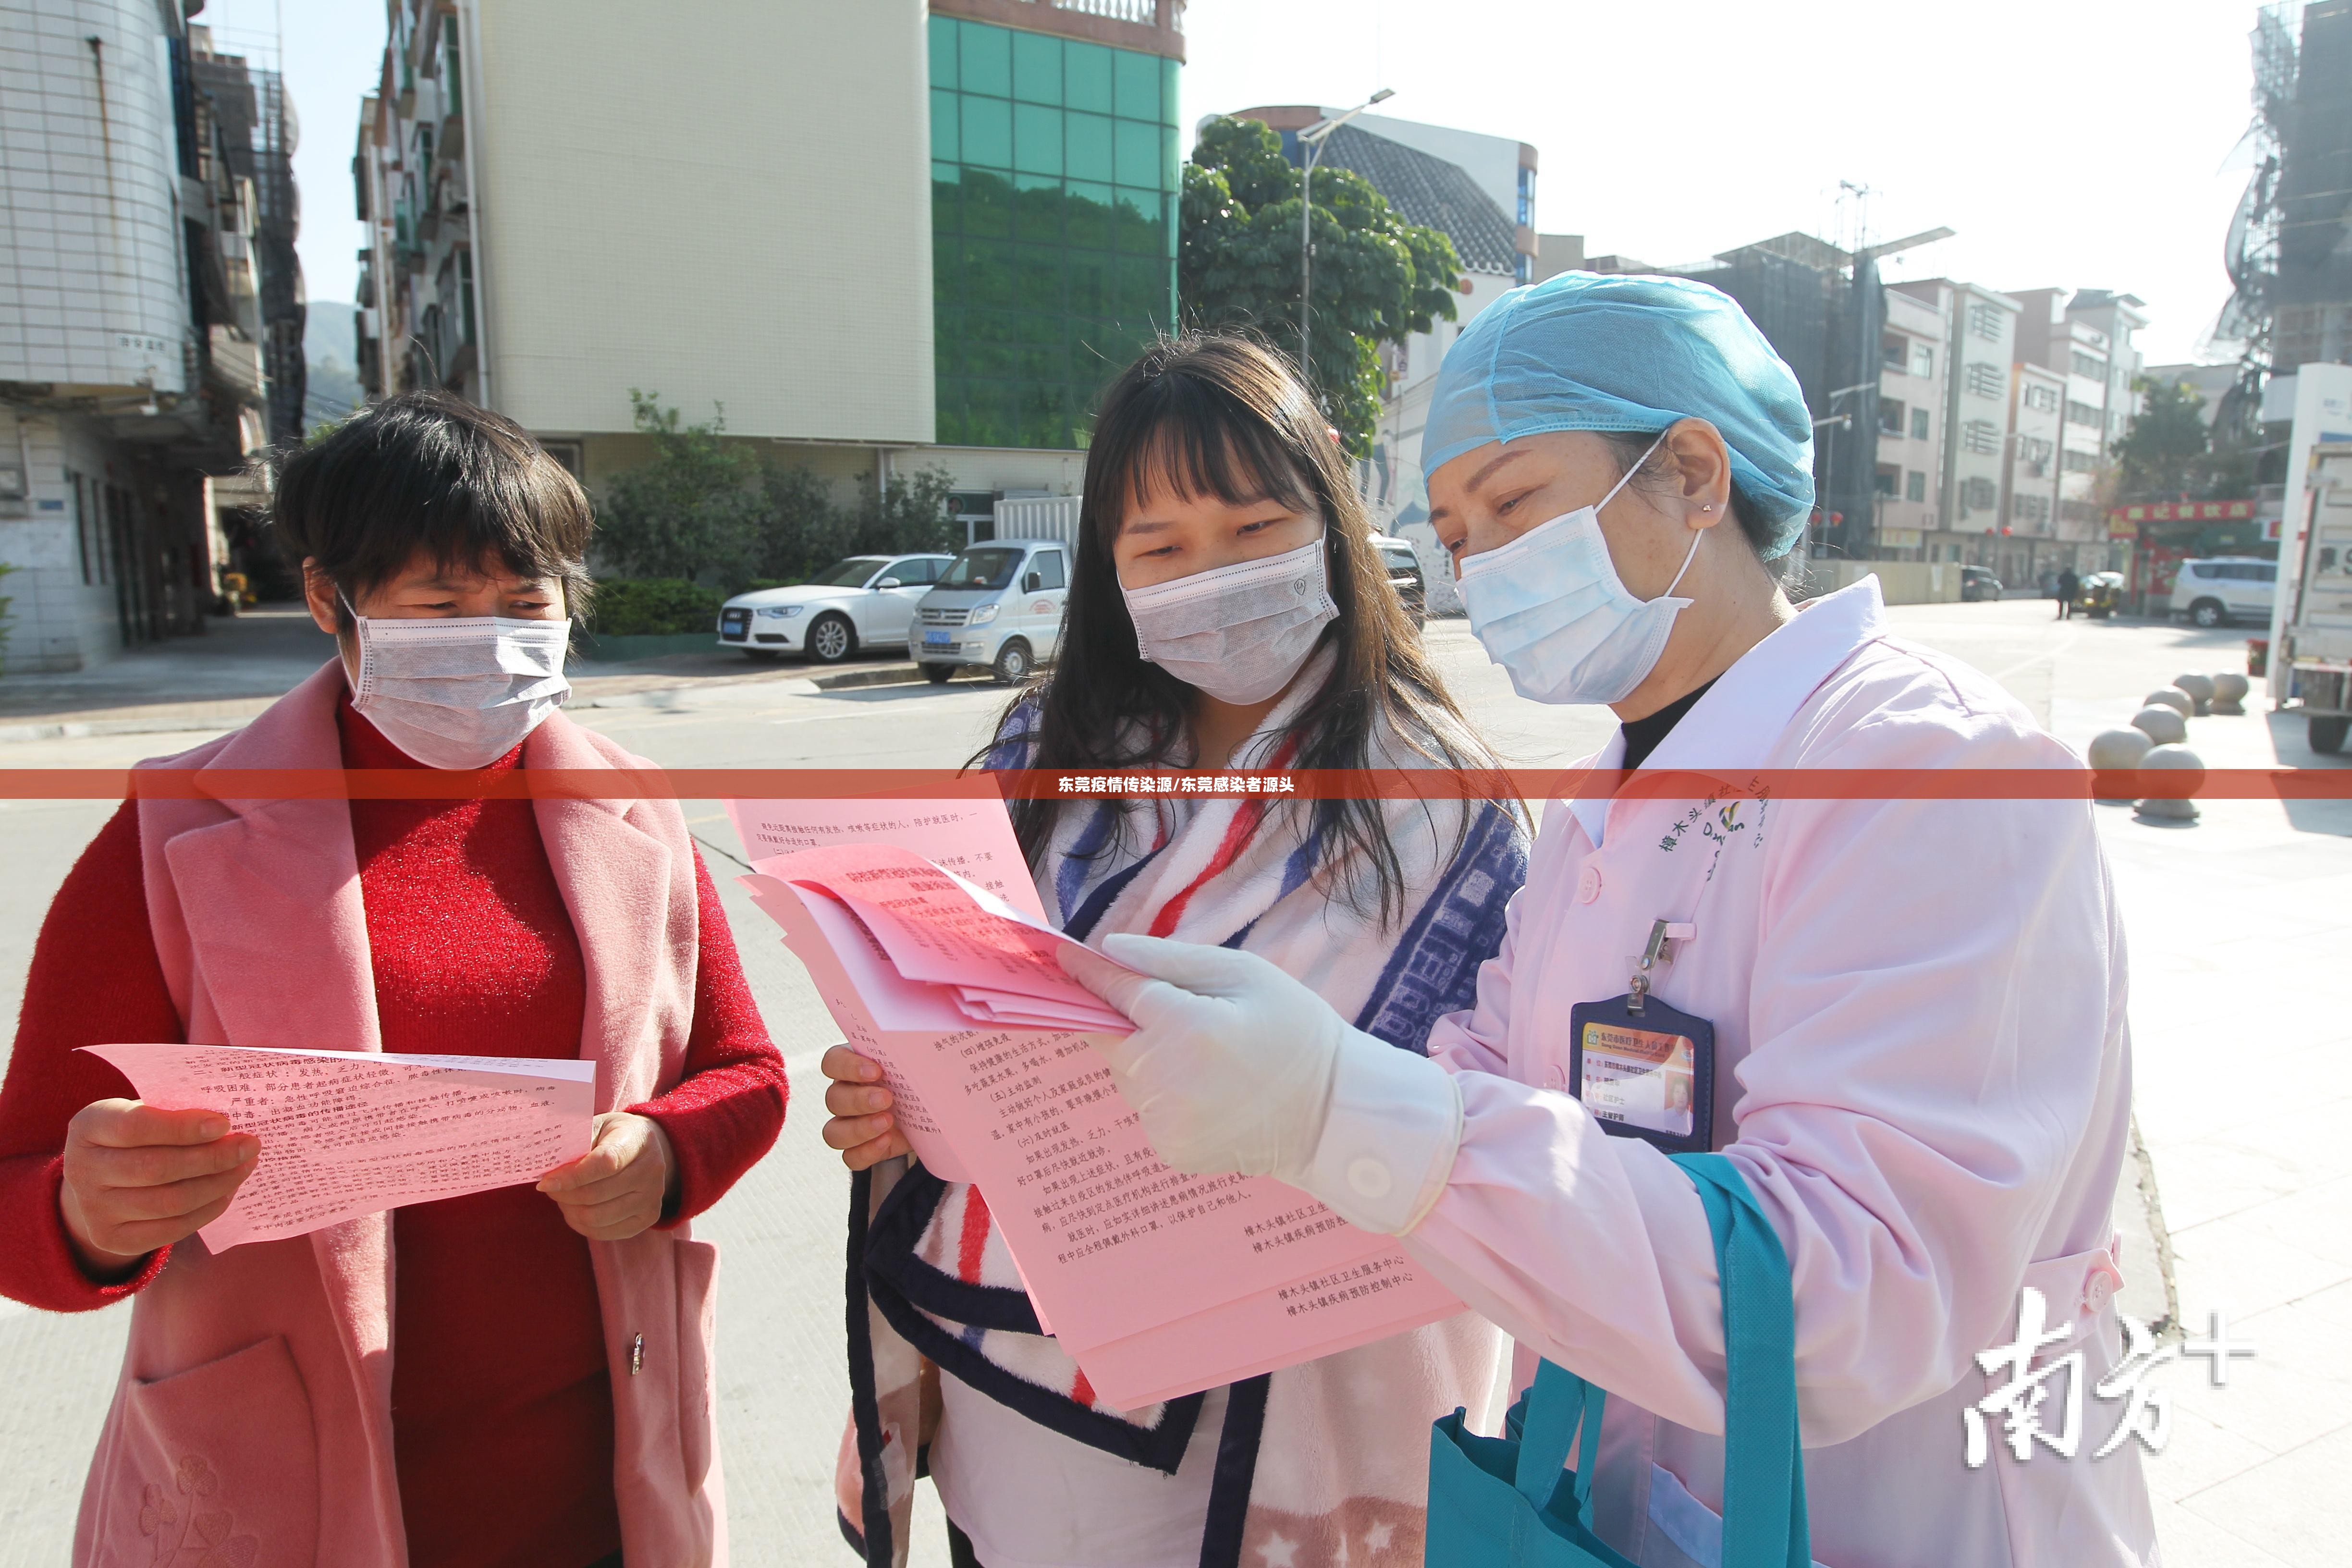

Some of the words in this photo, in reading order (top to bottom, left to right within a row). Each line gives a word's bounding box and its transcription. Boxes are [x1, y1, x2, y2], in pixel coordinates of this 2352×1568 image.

[985, 879, 1004, 890] 接触
[990, 1075, 1042, 1103] (五)主动监测
[1017, 1121, 1071, 1149] (六)及时就医
[1042, 1147, 1157, 1196] 如果出现上述症状，且有疫
[1277, 1255, 1404, 1301] 樟木头镇社区卫生服务中心
[1286, 1272, 1413, 1317] 樟木头镇疾病预防控制中心
